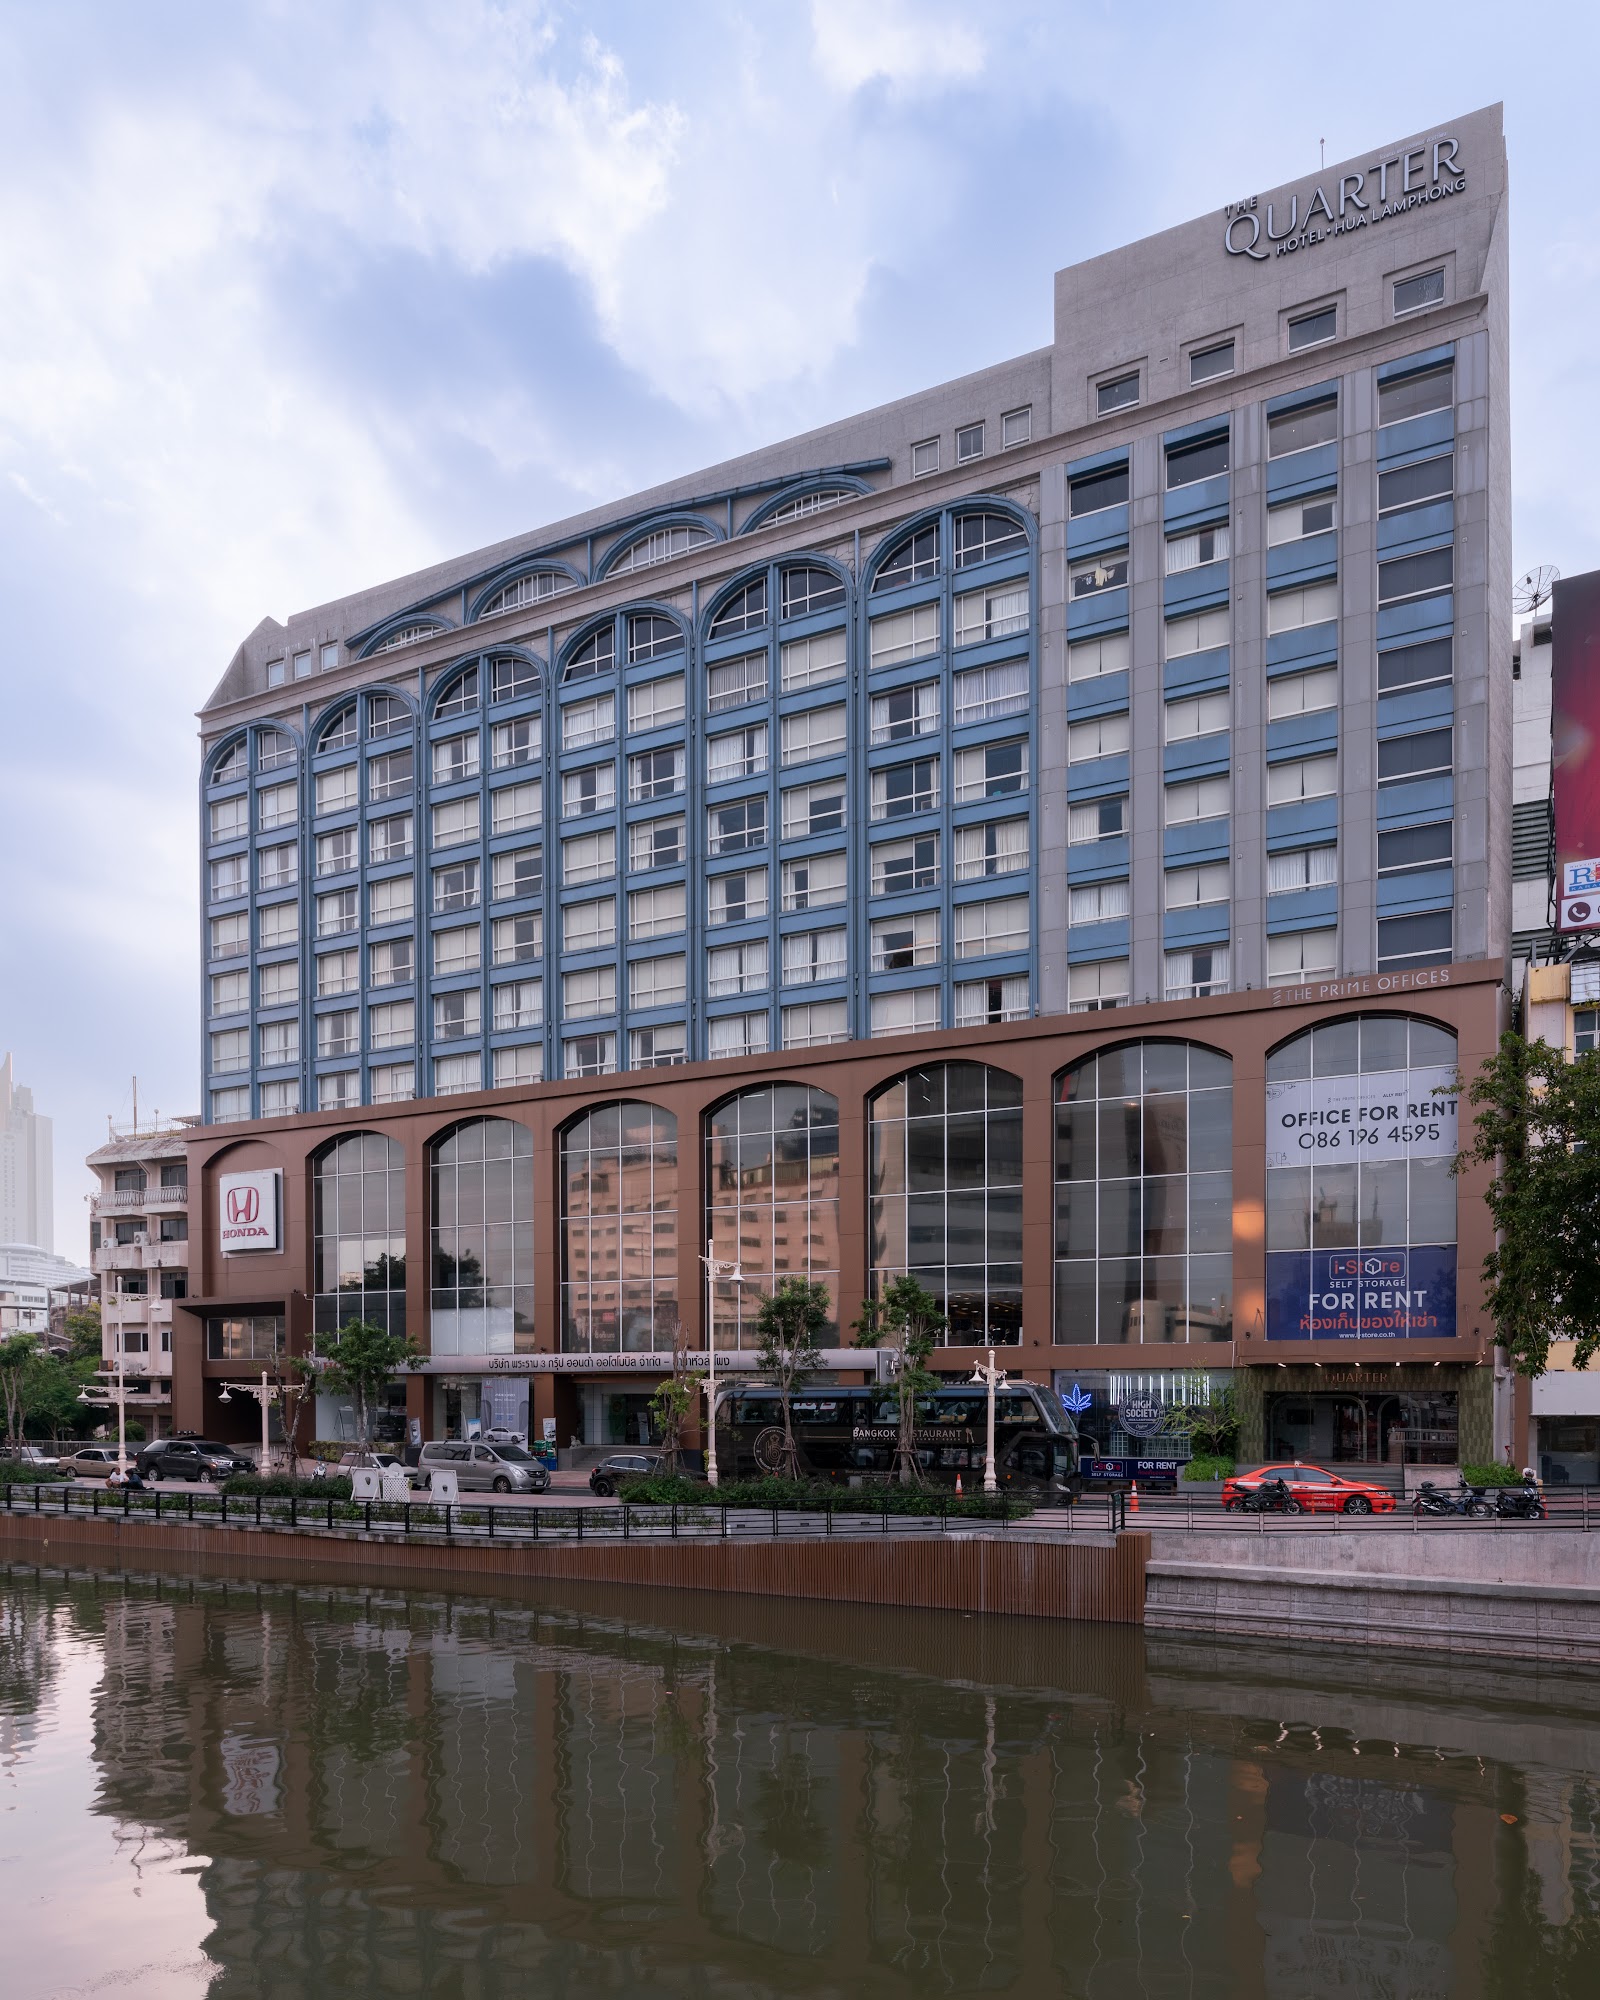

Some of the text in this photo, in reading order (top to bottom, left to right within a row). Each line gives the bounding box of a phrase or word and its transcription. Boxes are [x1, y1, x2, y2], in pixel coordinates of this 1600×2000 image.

[1224, 138, 1465, 260] QUARTER
[1225, 195, 1258, 218] THE
[1276, 177, 1466, 257] HOTEL HUA LAMPHONG
[1285, 969, 1449, 1002] THE PRIME OFFICES
[1281, 1100, 1458, 1128] OFFICE FOR RENT
[1298, 1123, 1440, 1149] 086 196 4595
[222, 1227, 269, 1239] HONDA
[1329, 1279, 1406, 1289] SELF STORAGE
[1309, 1290, 1427, 1311] FOR RENT
[1338, 1331, 1396, 1339] www.-store.co.th
[512, 1360, 539, 1369] พระราม
[541, 1360, 546, 1368] 3
[1325, 1372, 1388, 1385] QUARTER
[1132, 1400, 1151, 1409] HIGH
[1125, 1409, 1158, 1418] SOCIETY
[852, 1427, 962, 1438] BANGKOK STAURANT
[1137, 1461, 1154, 1470] FOR
[1156, 1461, 1177, 1470] RENT
